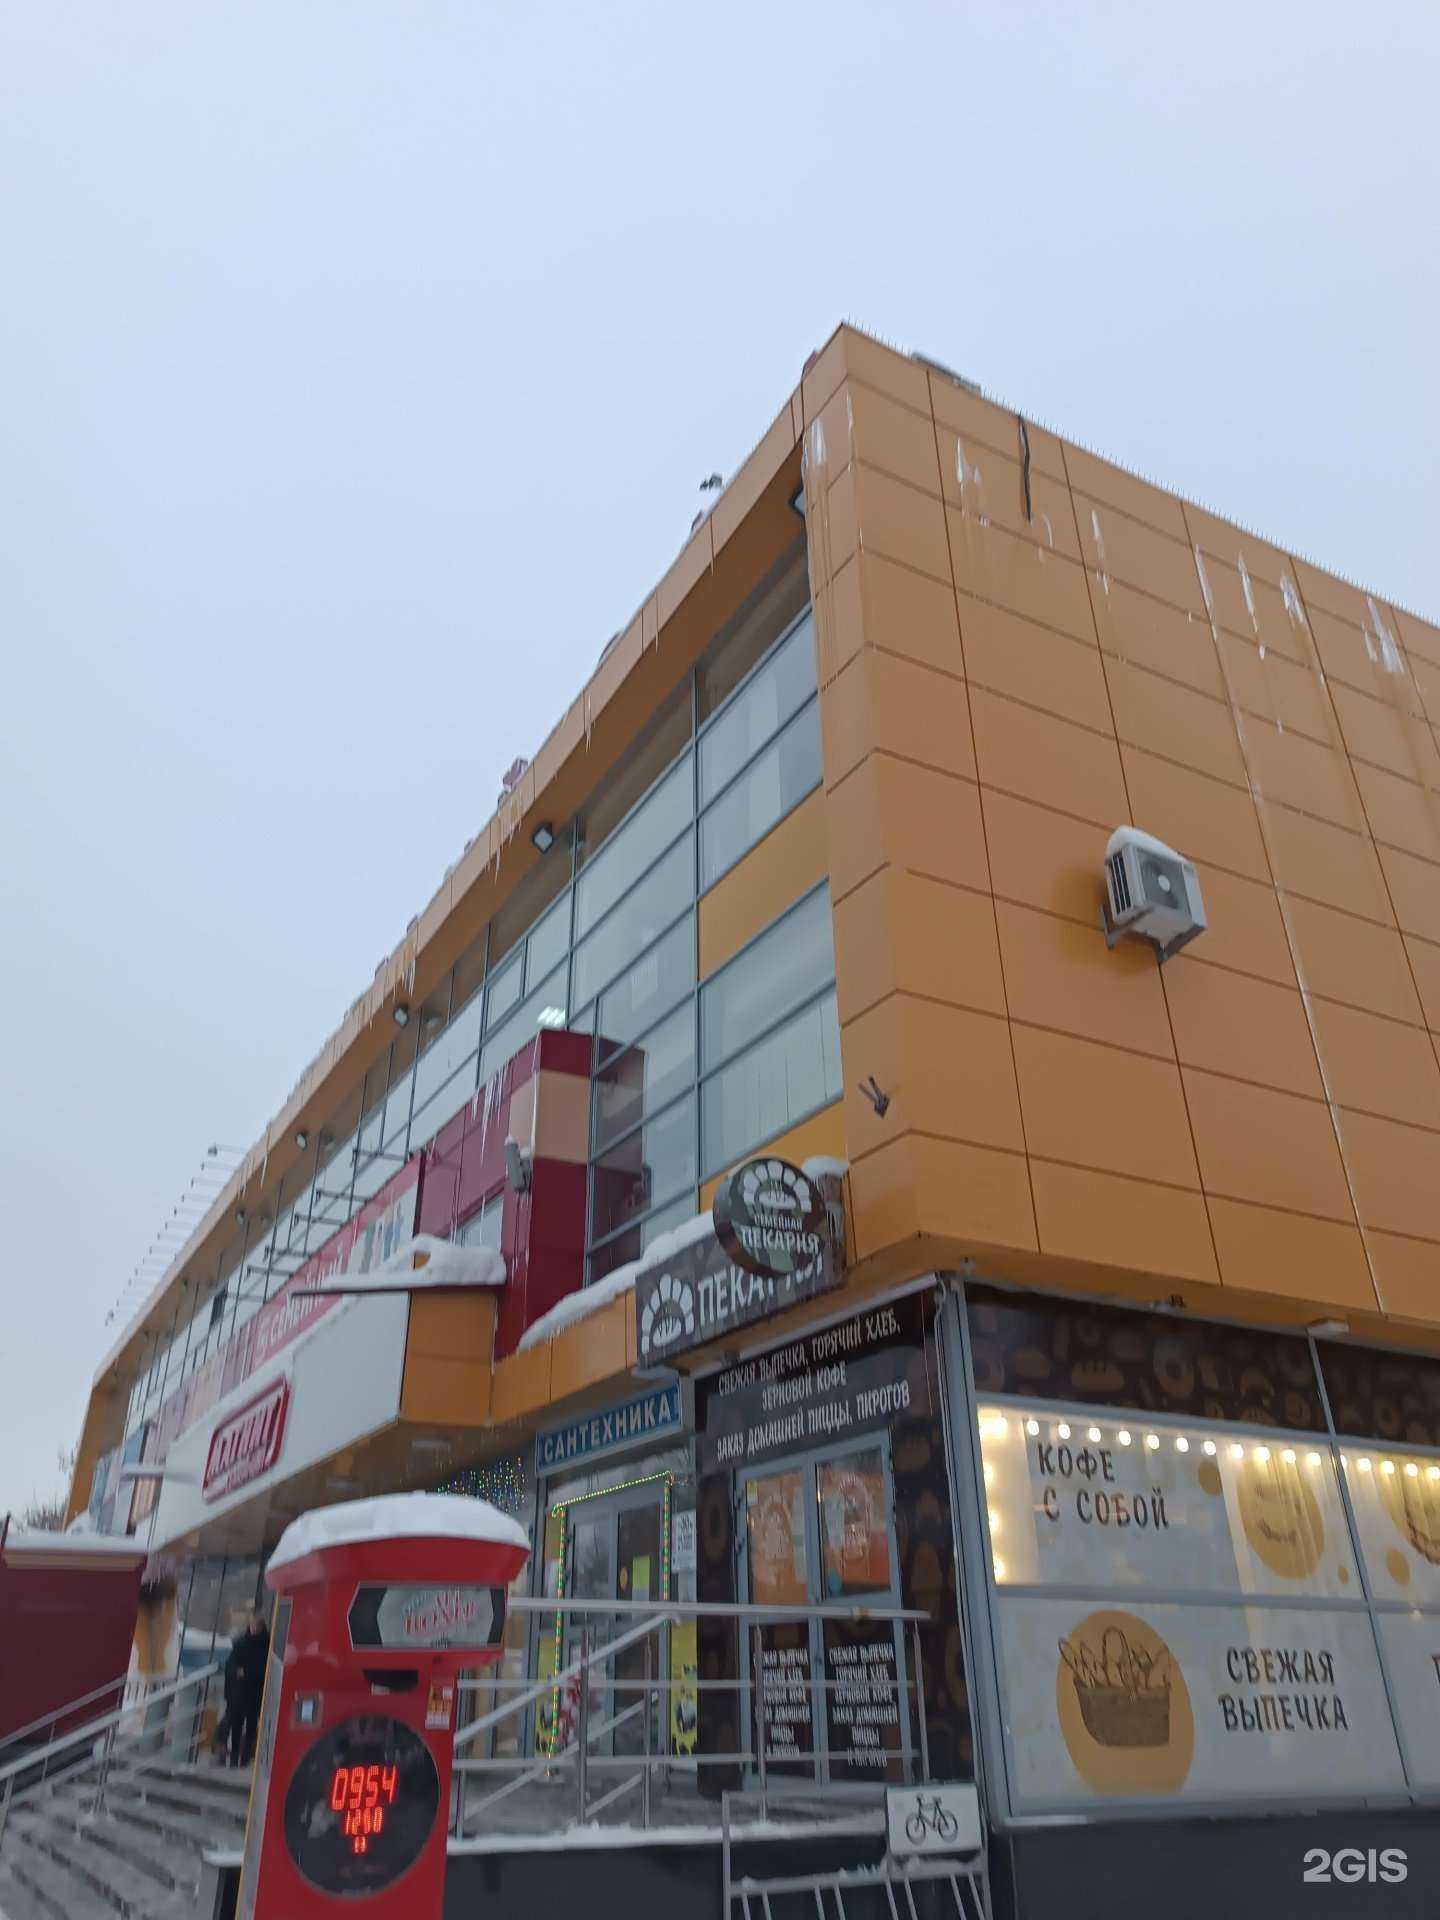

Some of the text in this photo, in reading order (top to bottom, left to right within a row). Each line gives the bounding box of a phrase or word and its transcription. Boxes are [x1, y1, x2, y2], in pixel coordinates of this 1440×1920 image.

[740, 1226, 820, 1255] ПЕКАРНЯ
[698, 1252, 823, 1326] ПЕКА
[762, 1362, 848, 1411] ЗЕРНОВОЙ КОФЕ
[544, 1391, 672, 1464] САНТЕХНИКА
[717, 1431, 744, 1462] ЗАКАЗ
[747, 1407, 805, 1458] ДОМАШНЕЙ
[856, 1379, 910, 1422] ПИРОГОВ
[1038, 1442, 1115, 1482] КОФЕ
[1043, 1486, 1169, 1530] С СОБОЙ
[1226, 1646, 1335, 1685] СВЕЖАЯ
[1218, 1693, 1349, 1732] ВЫПЕЧКА
[332, 1765, 397, 1810] 0954
